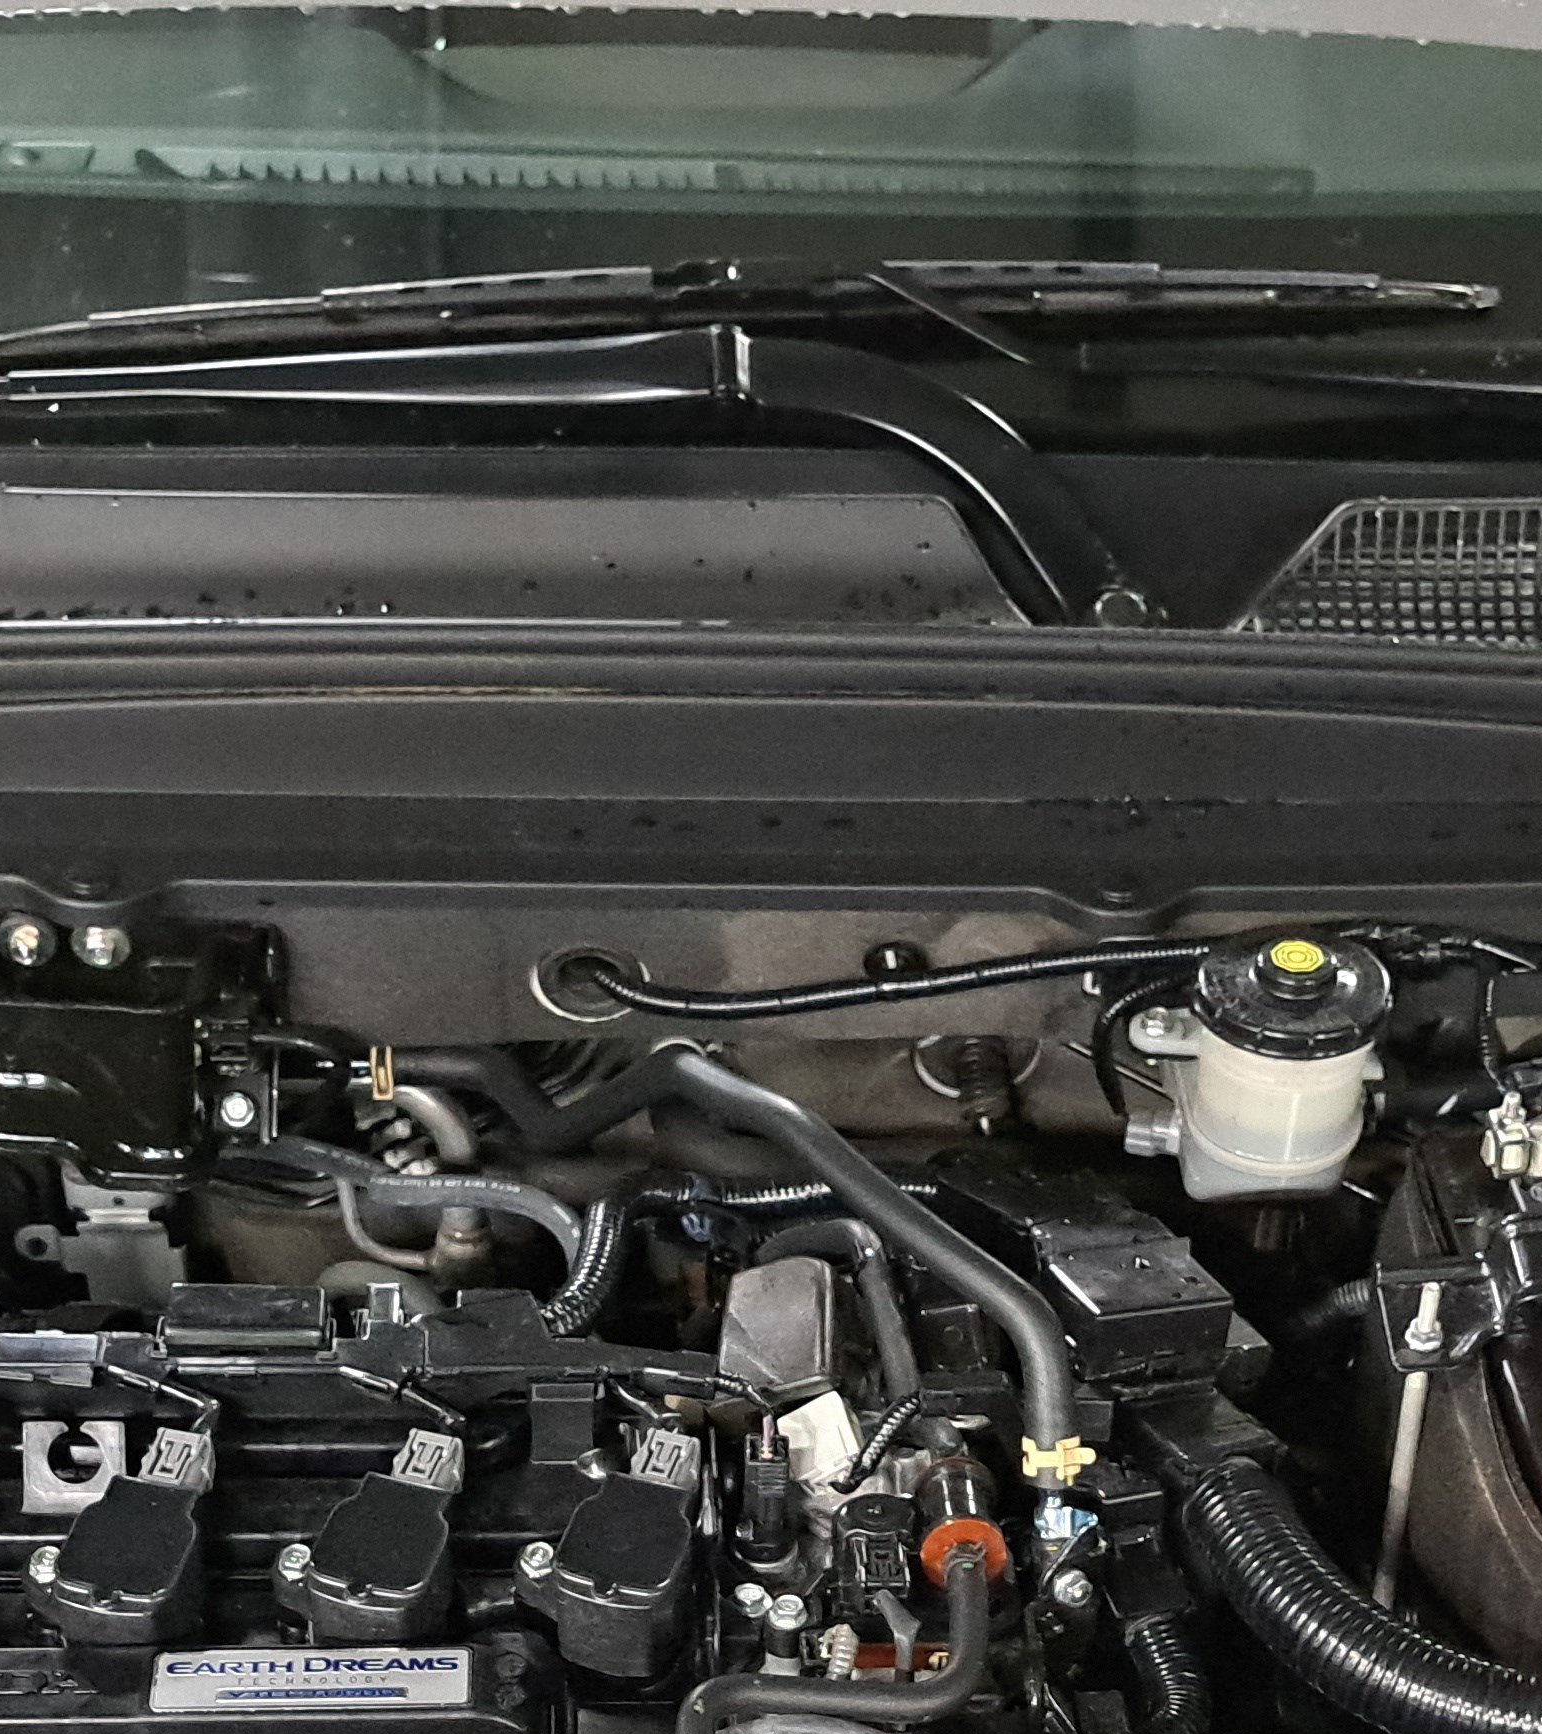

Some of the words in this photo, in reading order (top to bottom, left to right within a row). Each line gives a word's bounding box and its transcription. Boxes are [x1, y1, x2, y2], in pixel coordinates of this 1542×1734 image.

[165, 1660, 294, 1675] EARTH
[303, 1656, 459, 1672] DREAMS
[236, 1675, 389, 1686] TECHNOLOGY
